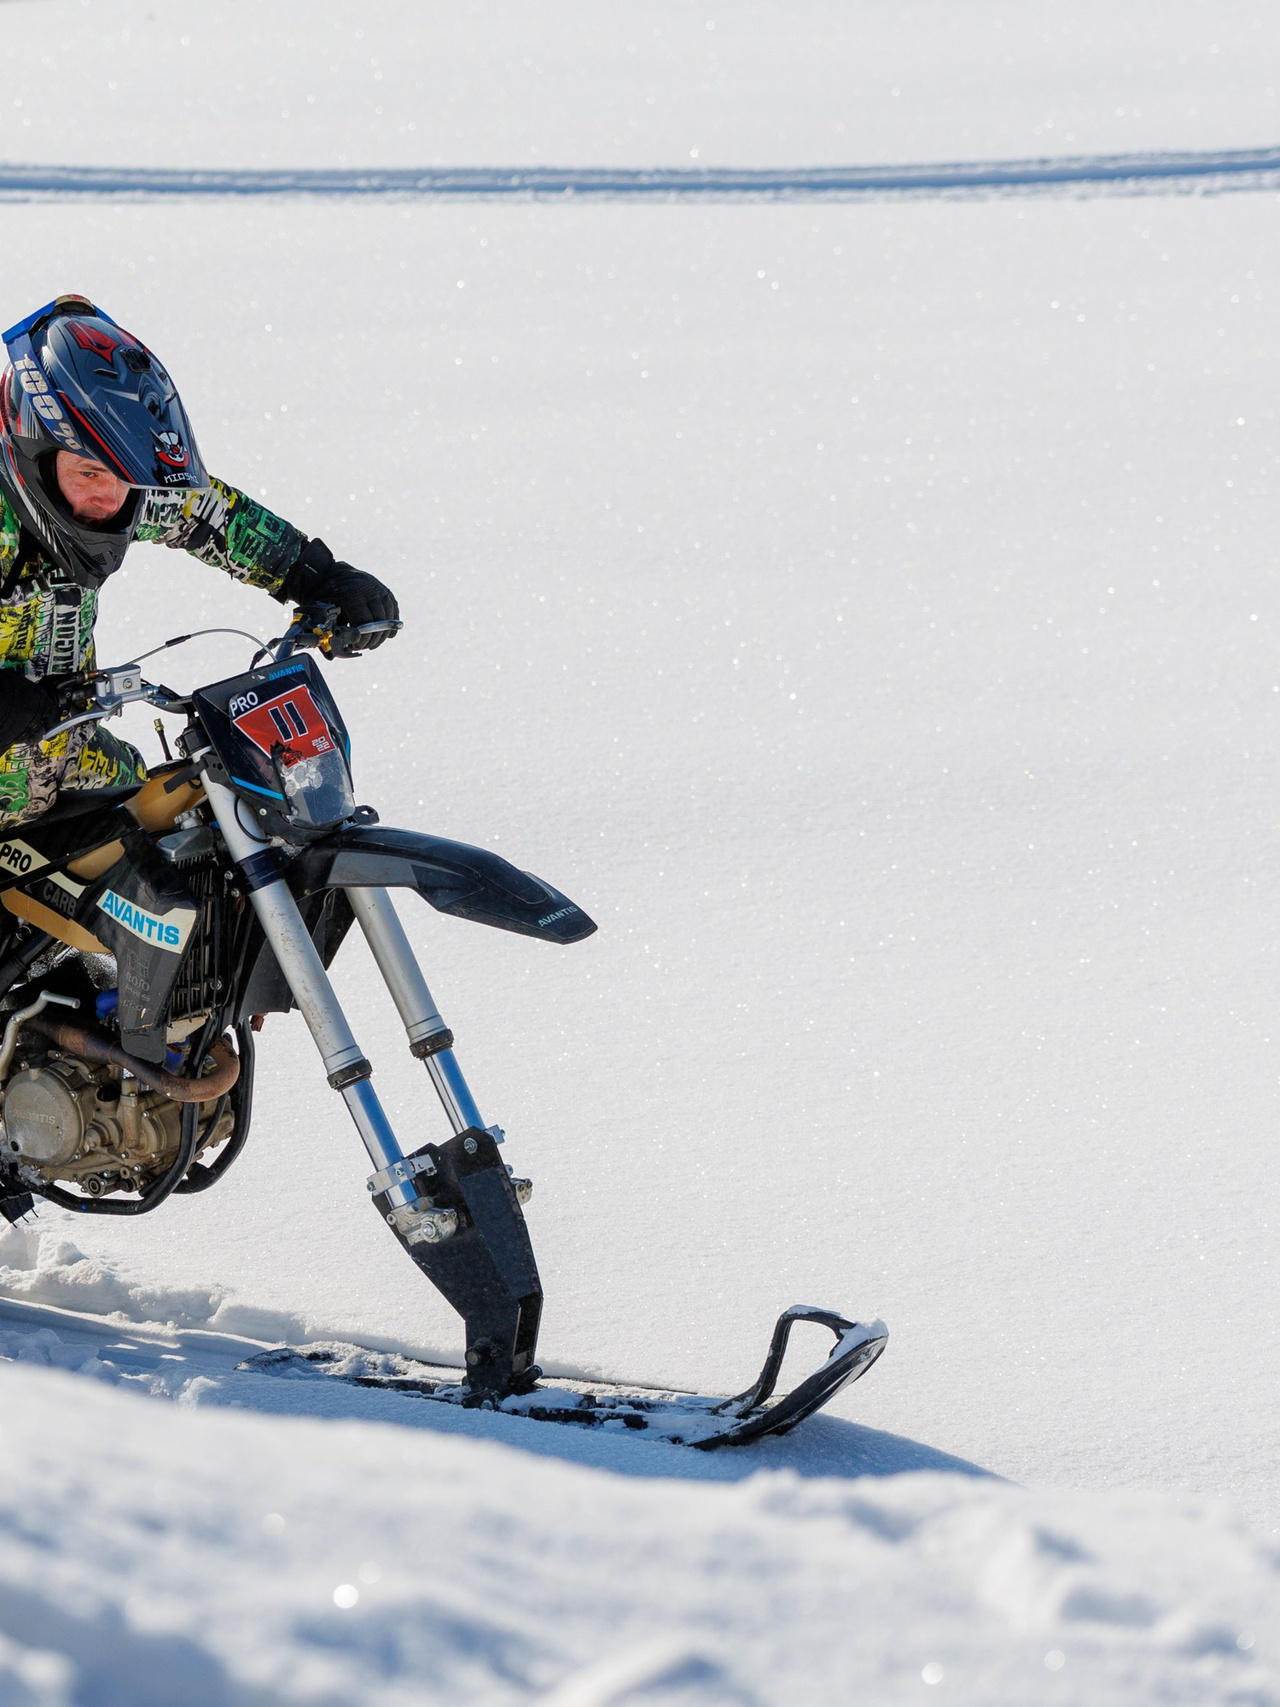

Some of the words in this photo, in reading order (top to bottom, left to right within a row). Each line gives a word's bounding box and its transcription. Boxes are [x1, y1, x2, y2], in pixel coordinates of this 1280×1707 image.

[269, 664, 304, 681] AVANTIS
[230, 691, 258, 717] PRO
[268, 700, 308, 742] 11
[42, 881, 77, 918] CARB
[102, 891, 180, 946] AVANTIS
[538, 905, 578, 927] AVANTIS
